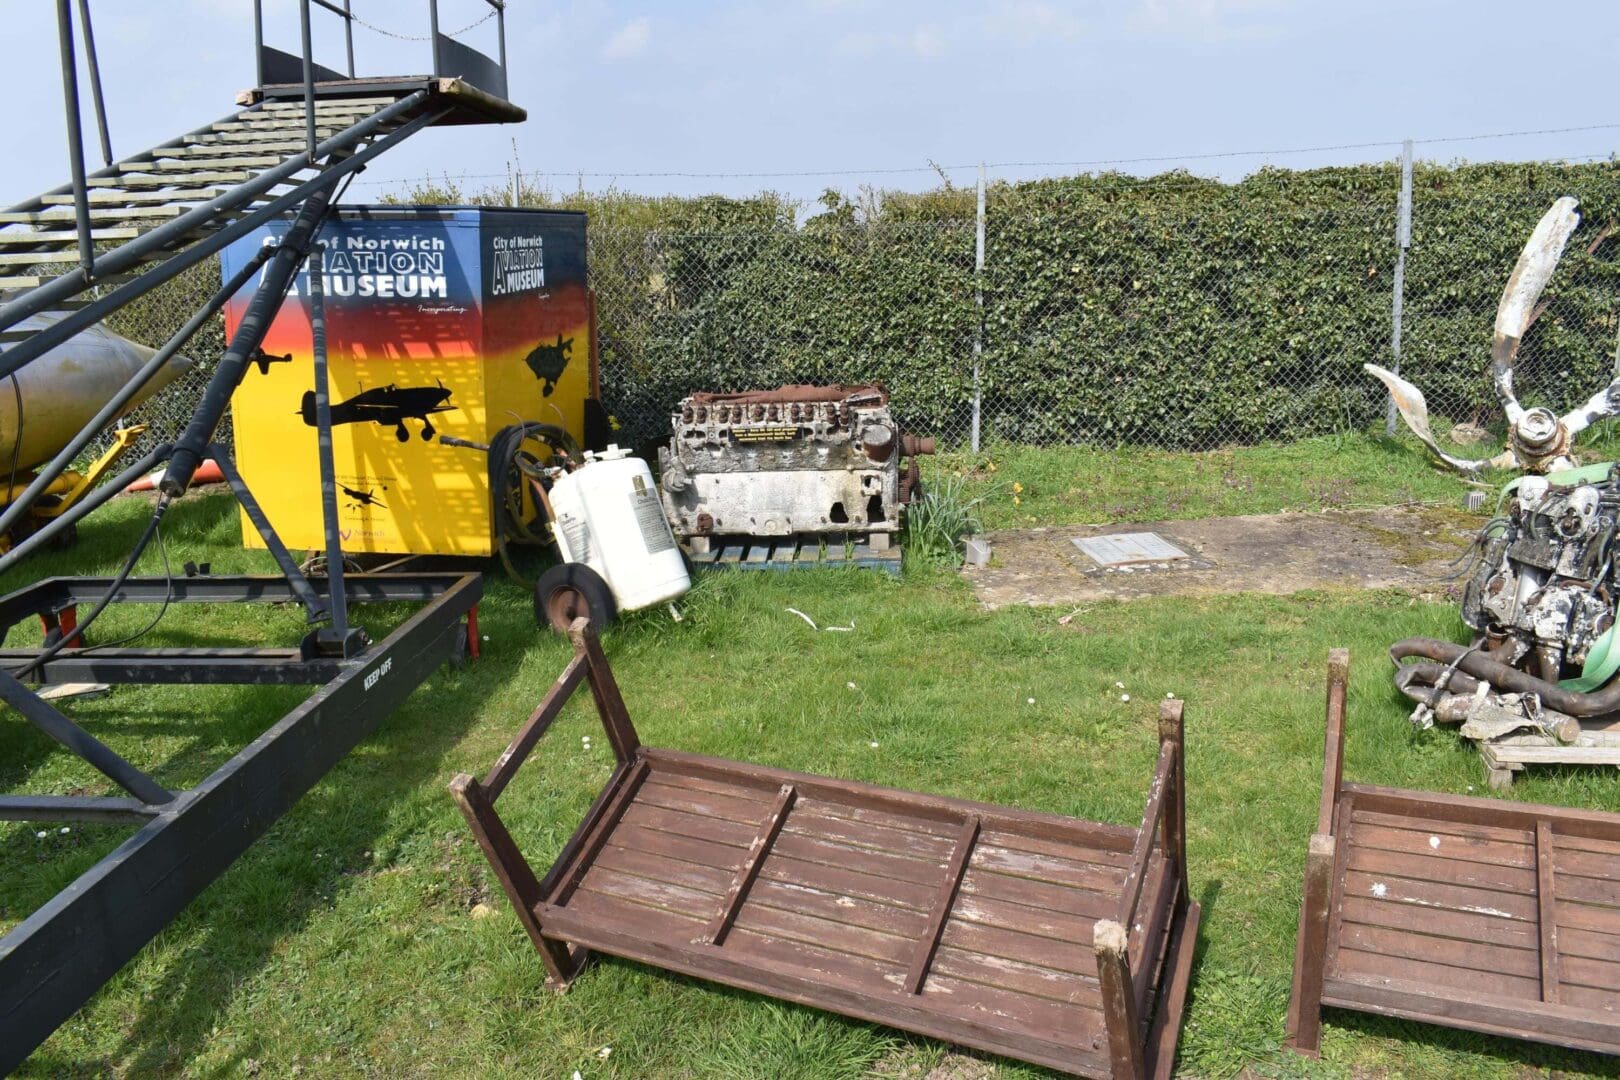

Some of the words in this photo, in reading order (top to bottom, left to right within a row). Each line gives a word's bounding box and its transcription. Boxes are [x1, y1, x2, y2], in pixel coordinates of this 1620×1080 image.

[347, 235, 445, 250] Norwich
[493, 236, 508, 251] City
[509, 236, 516, 248] of
[517, 234, 543, 248] Norwich
[492, 248, 543, 296] AVIATION
[507, 268, 545, 293] MUSEUM
[363, 668, 380, 692] KEEP
[380, 657, 392, 676] OFF
